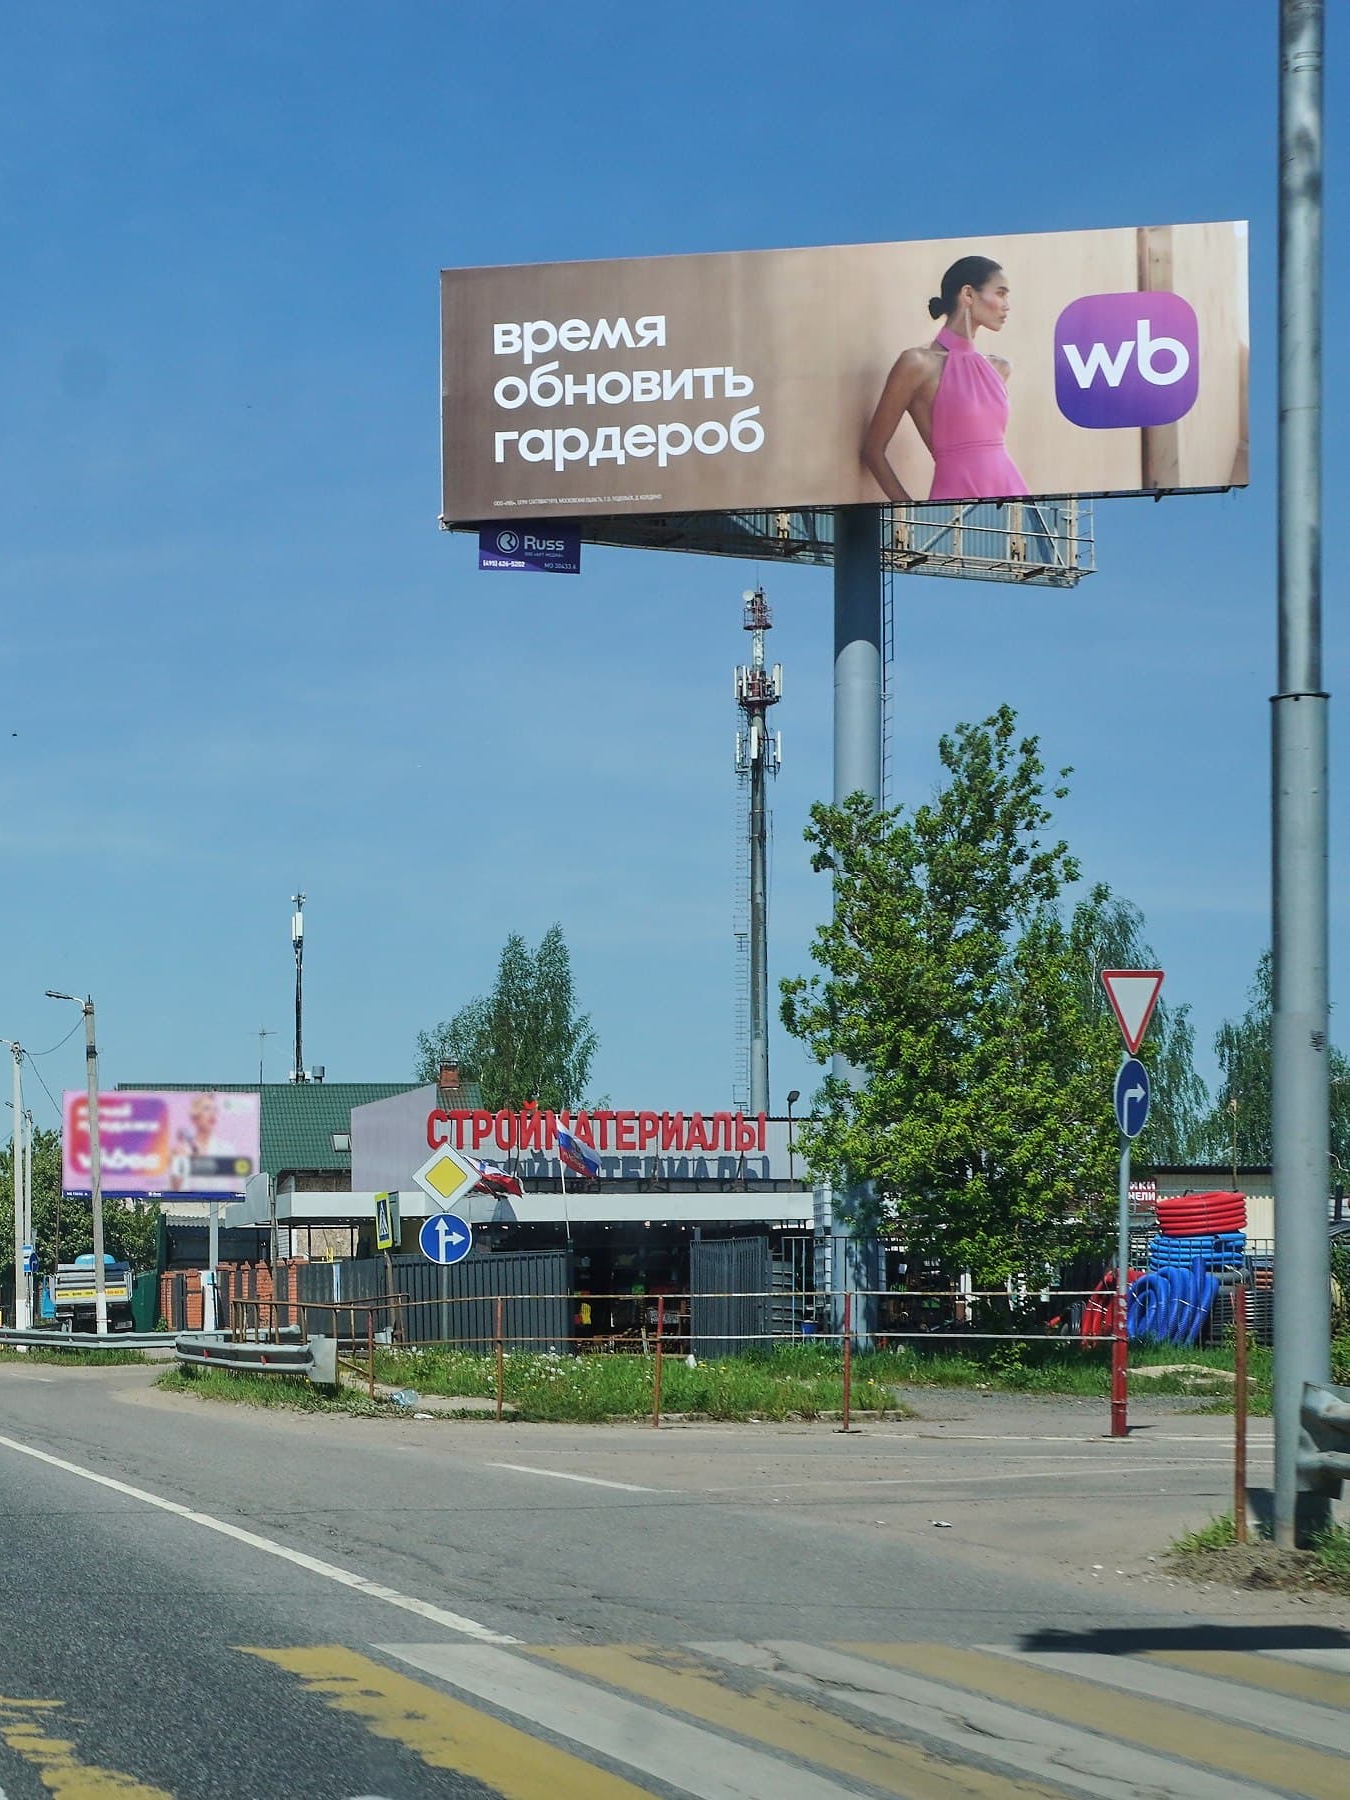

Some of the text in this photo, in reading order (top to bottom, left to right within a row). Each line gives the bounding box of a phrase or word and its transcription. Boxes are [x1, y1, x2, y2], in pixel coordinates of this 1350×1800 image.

[493, 315, 666, 364] время
[1062, 319, 1190, 389] wb
[493, 361, 754, 410] обновить
[494, 406, 765, 472] гардероб
[524, 535, 565, 551] Russ
[426, 1101, 766, 1152] СТРОЙМАТЕРИАЛЫ
